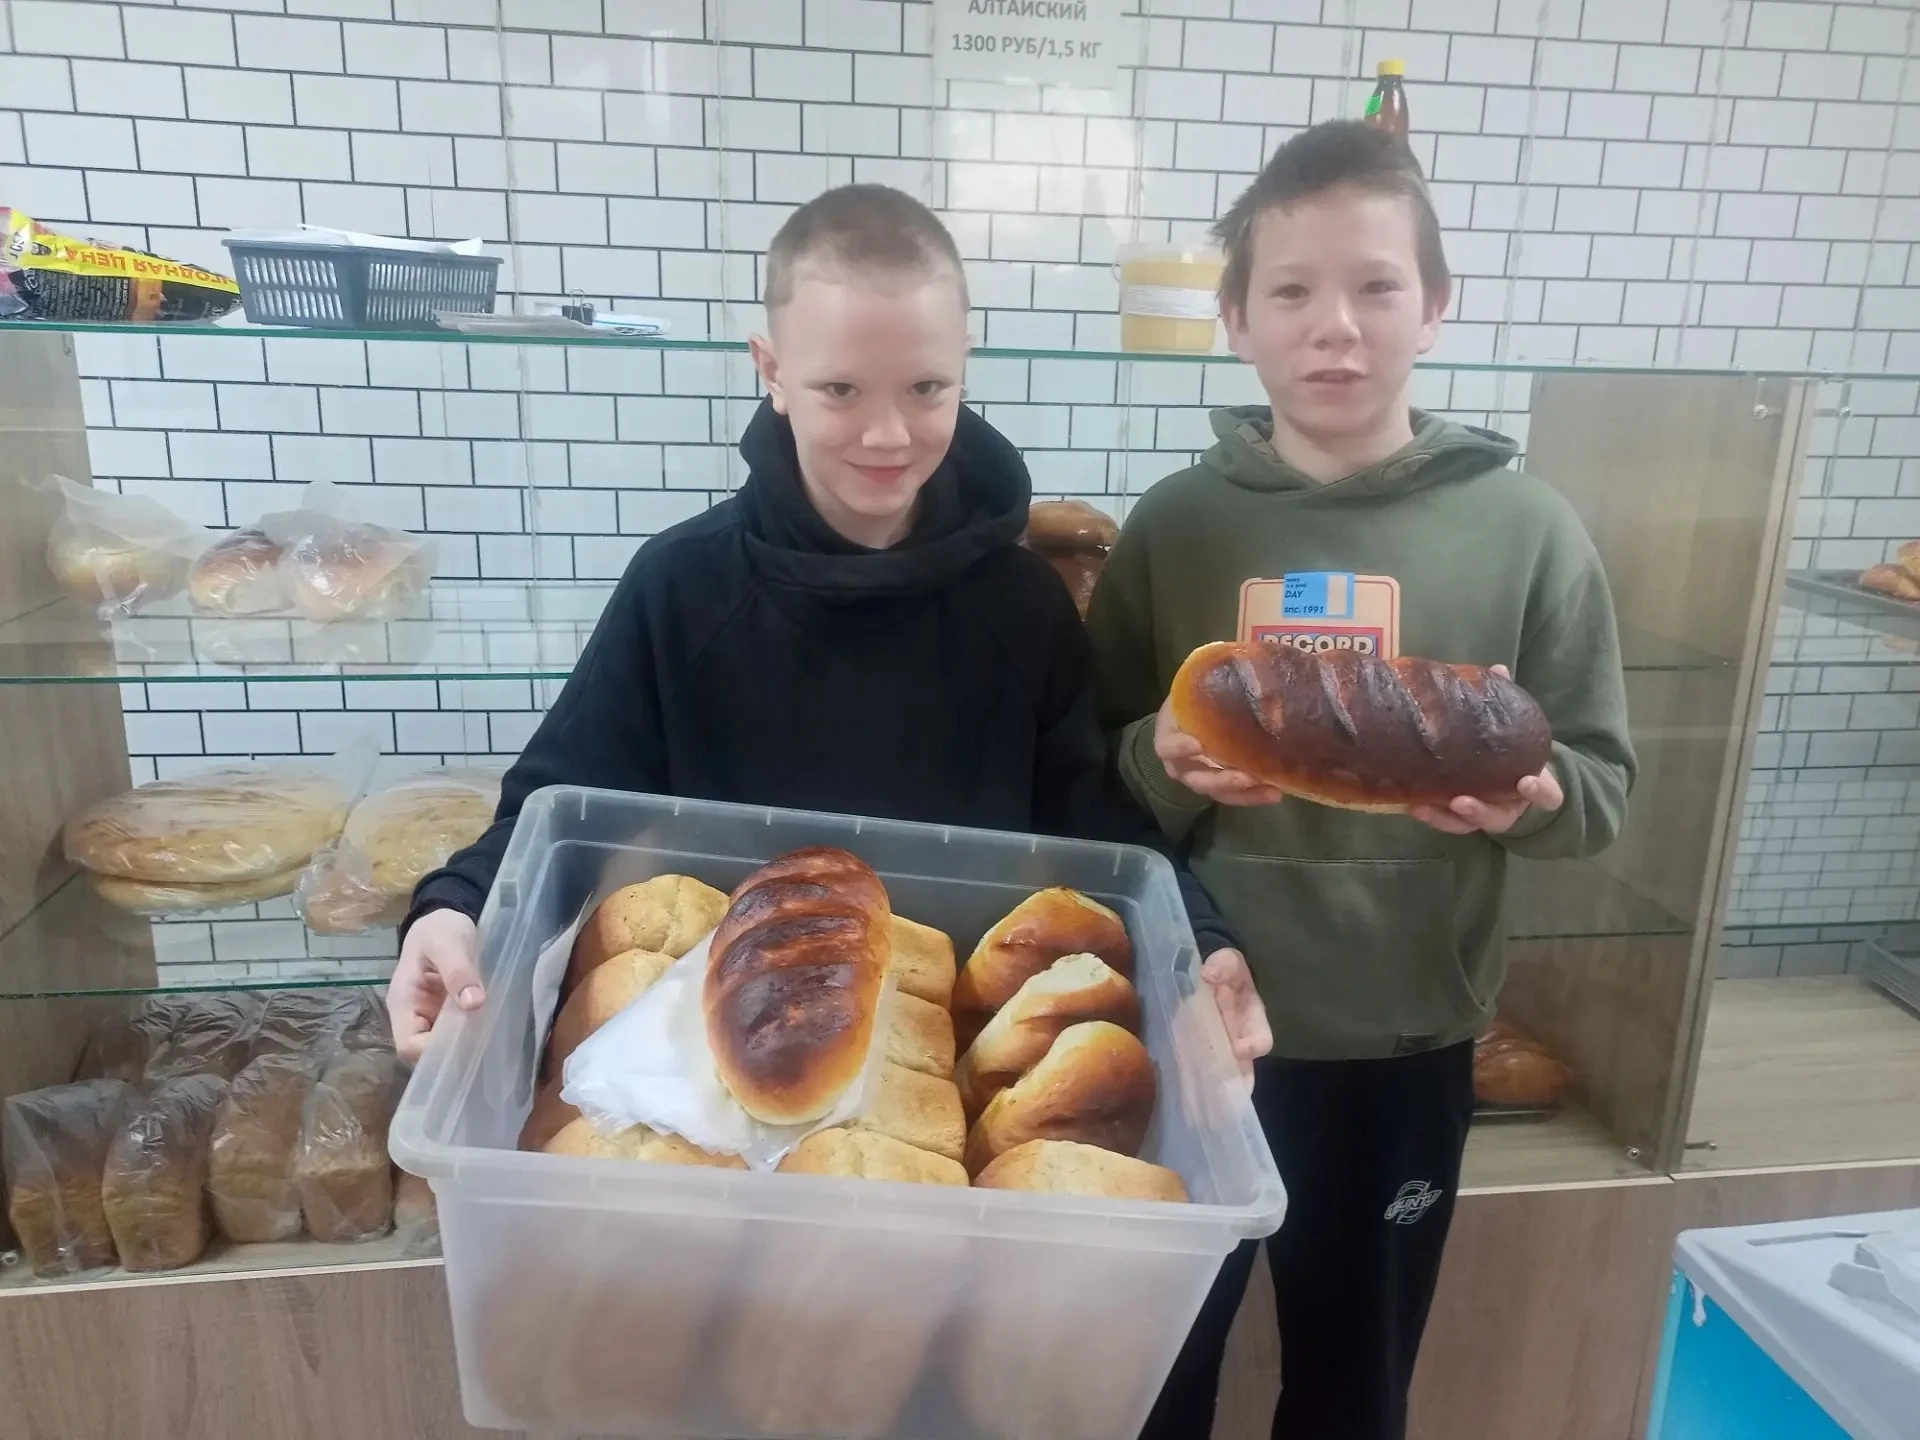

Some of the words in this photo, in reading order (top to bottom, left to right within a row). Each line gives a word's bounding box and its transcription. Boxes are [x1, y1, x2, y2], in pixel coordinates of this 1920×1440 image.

[952, 33, 996, 52] 1300
[1002, 36, 1074, 59] РУБ/1,5
[1080, 41, 1102, 58] КГ
[64, 246, 126, 271] ЦЕНА
[133, 258, 235, 285] ГОДНАЯ
[1284, 590, 1304, 599] DAY
